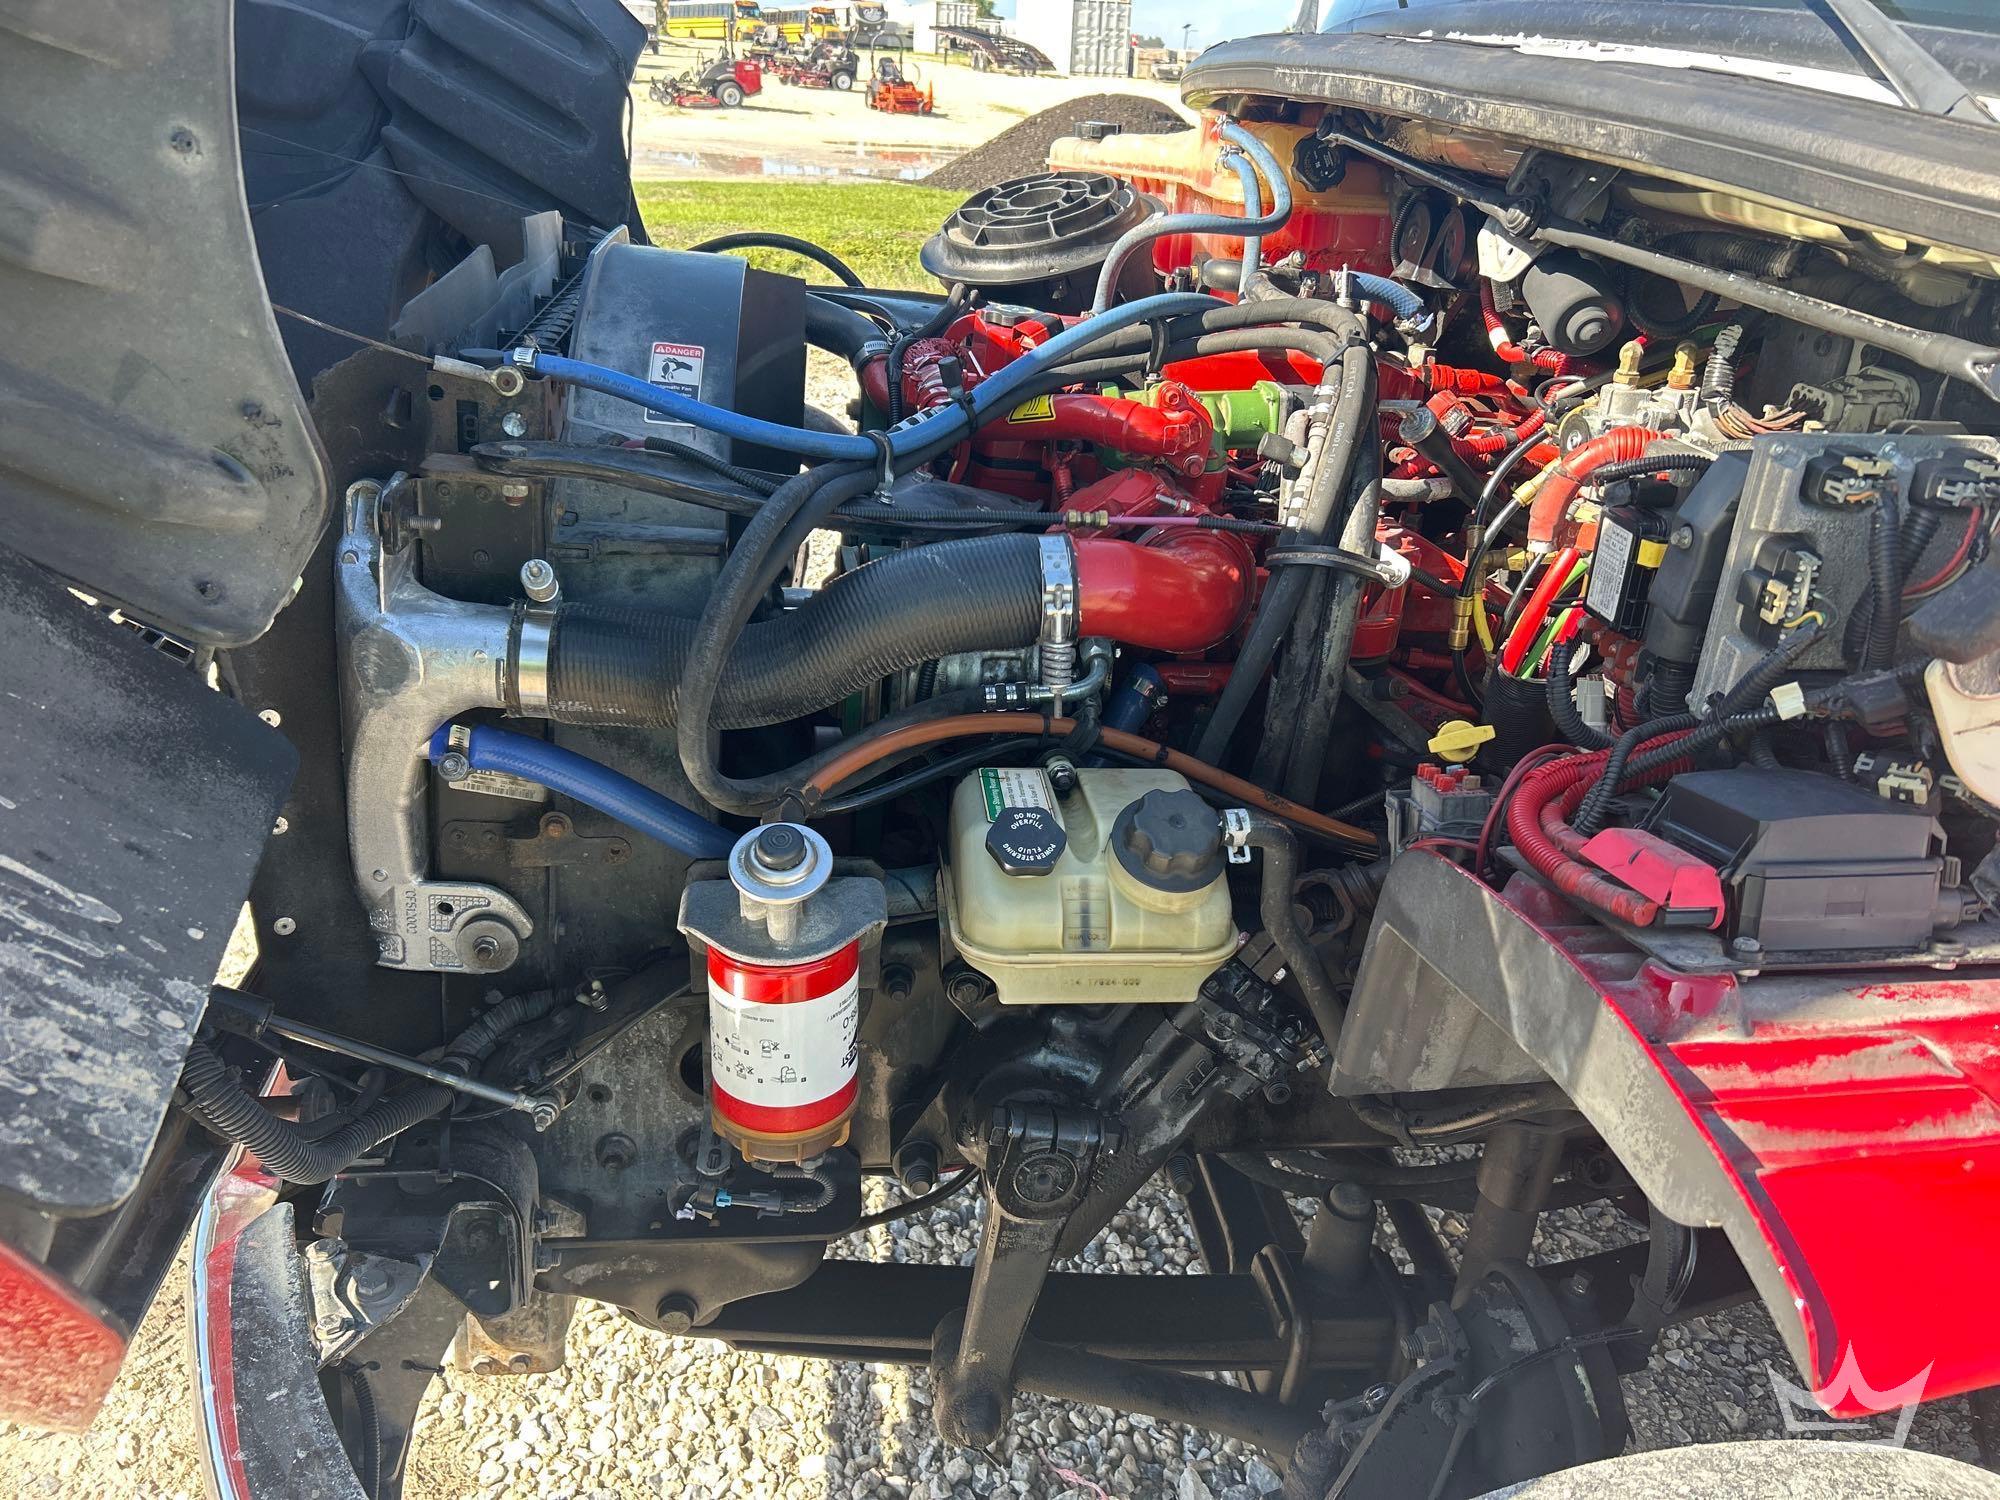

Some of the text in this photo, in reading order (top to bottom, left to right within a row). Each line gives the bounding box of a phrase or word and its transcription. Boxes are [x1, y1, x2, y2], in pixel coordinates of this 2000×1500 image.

[665, 347, 701, 357] DANGER
[1345, 360, 1358, 399] EATON
[1026, 812, 1041, 820] NOT
[1010, 819, 1044, 830] OVERFILL
[1002, 843, 1056, 861] POWER STEERING
[1017, 846, 1042, 855] FLUID
